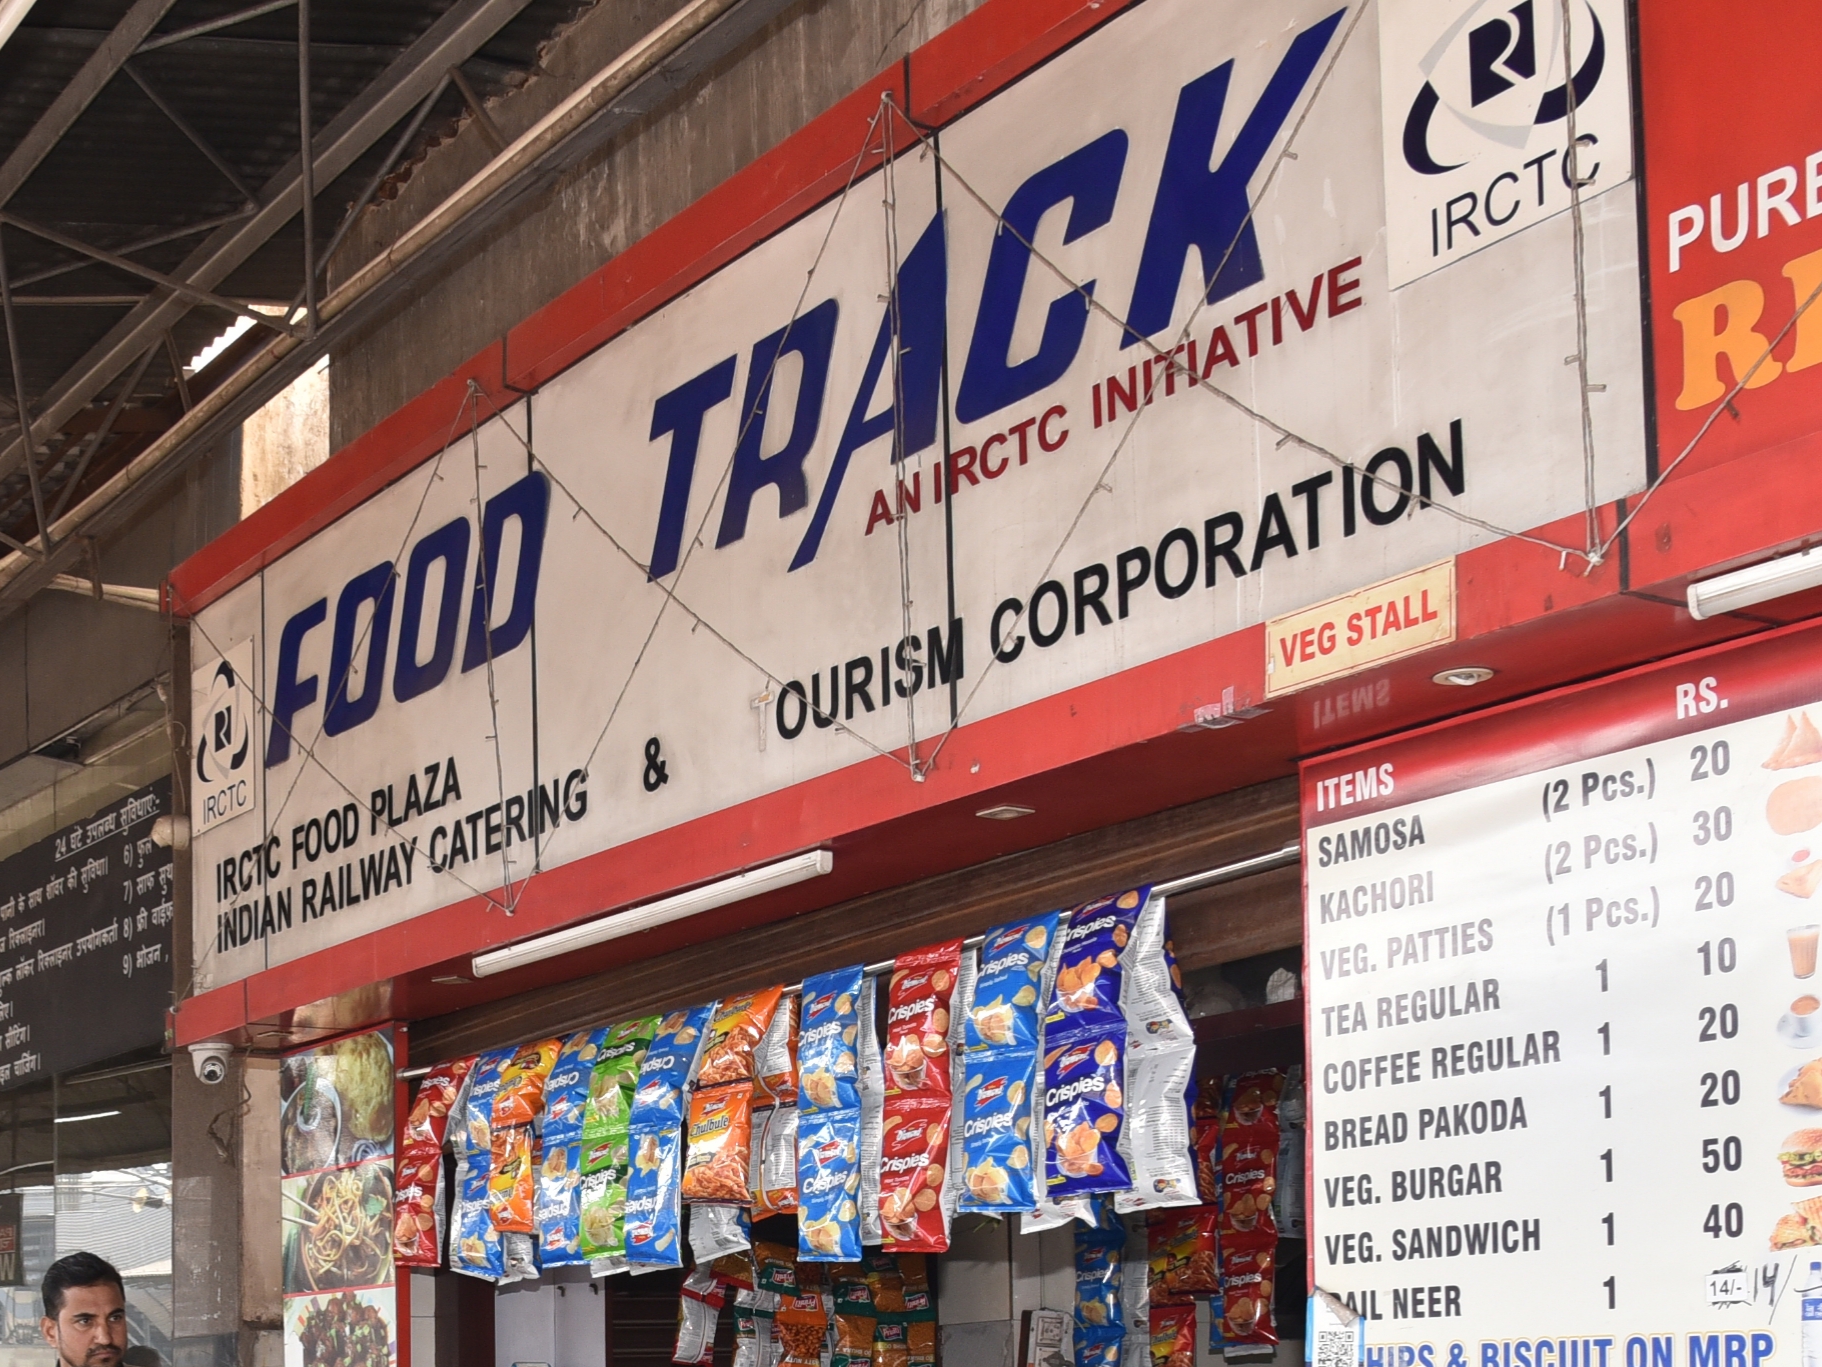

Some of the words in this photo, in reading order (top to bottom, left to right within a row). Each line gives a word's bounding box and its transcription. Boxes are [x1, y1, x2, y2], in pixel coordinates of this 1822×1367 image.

[1431, 134, 1600, 257] IRCTC
[266, 471, 549, 768] FOOD
[648, 8, 1347, 583] TRACK
[865, 469, 921, 536] AN
[932, 405, 1069, 506] IRCTC
[1092, 257, 1362, 428] INITIATIVE
[990, 418, 1466, 663] CORPORATION
[1279, 621, 1337, 668] VEG
[1348, 589, 1439, 649] STALL
[1316, 763, 1395, 812] ITEMS
[1676, 676, 1730, 720] RS.
[203, 779, 246, 825] IRCTC
[215, 839, 282, 904] IRCTC
[292, 803, 360, 871] FOOD
[371, 756, 462, 837] PLAZA
[1318, 815, 1426, 868] SAMOSA
[1542, 781, 1571, 822] (2
[1582, 758, 1657, 807] Pcs.)
[1690, 740, 1731, 782] 20
[55, 836, 67, 860] 24
[86, 812, 118, 844] उपलब्ध
[123, 842, 134, 868] 6)
[217, 887, 293, 953] INDIAN
[301, 840, 417, 925] RAILWAY
[429, 768, 588, 874] CATERING
[642, 737, 669, 793] &
[1320, 871, 1435, 925] KACHORI
[1545, 842, 1572, 884] (2
[1584, 821, 1659, 870] Pcs.)
[1692, 805, 1733, 846] 30
[0, 896, 16, 922] पानी
[17, 892, 26, 913] के
[28, 887, 44, 910] साथ
[67, 866, 78, 891] की
[123, 879, 133, 905] 7)
[123, 916, 133, 941] 8)
[1320, 944, 1378, 981] VEG.
[1387, 918, 1495, 969] PATTIES
[1545, 905, 1571, 946] (1
[1586, 885, 1661, 932] Pcs.)
[1694, 871, 1735, 912] 20
[122, 952, 133, 979] 9)
[1322, 1001, 1367, 1038] TEA
[1378, 978, 1501, 1030] REGULAR
[1595, 959, 1609, 993] 1
[1697, 937, 1738, 977] 10
[798, 1020, 842, 1047] Crispies
[888, 999, 935, 1024] Crispies
[1323, 1050, 1421, 1094] COFFEE
[1432, 1030, 1561, 1081] REGULAR
[1597, 1022, 1612, 1056] 1
[1698, 1003, 1739, 1043] 20
[1045, 1075, 1105, 1108] Crispies
[1324, 1112, 1409, 1152] BREAD
[1418, 1096, 1528, 1141] PAKODA
[1599, 1085, 1613, 1119] 1
[1700, 1069, 1741, 1108] 20
[690, 1114, 730, 1138] Chulbule
[963, 1111, 1014, 1138] Crispies
[880, 1153, 929, 1175] Crispies
[1225, 1167, 1265, 1185] Crispies
[1324, 1172, 1381, 1208] VEG.
[1391, 1160, 1503, 1203] BURGAR
[1600, 1148, 1614, 1182] 1
[1701, 1135, 1743, 1174] 50
[1325, 1231, 1382, 1266] VEG.
[1391, 1218, 1541, 1262] SANDWICH
[1601, 1212, 1615, 1247] 1
[1703, 1202, 1745, 1240] 40
[1392, 1284, 1462, 1320] NEER
[1603, 1275, 1617, 1309] 1
[1710, 1278, 1743, 1297] 14/-
